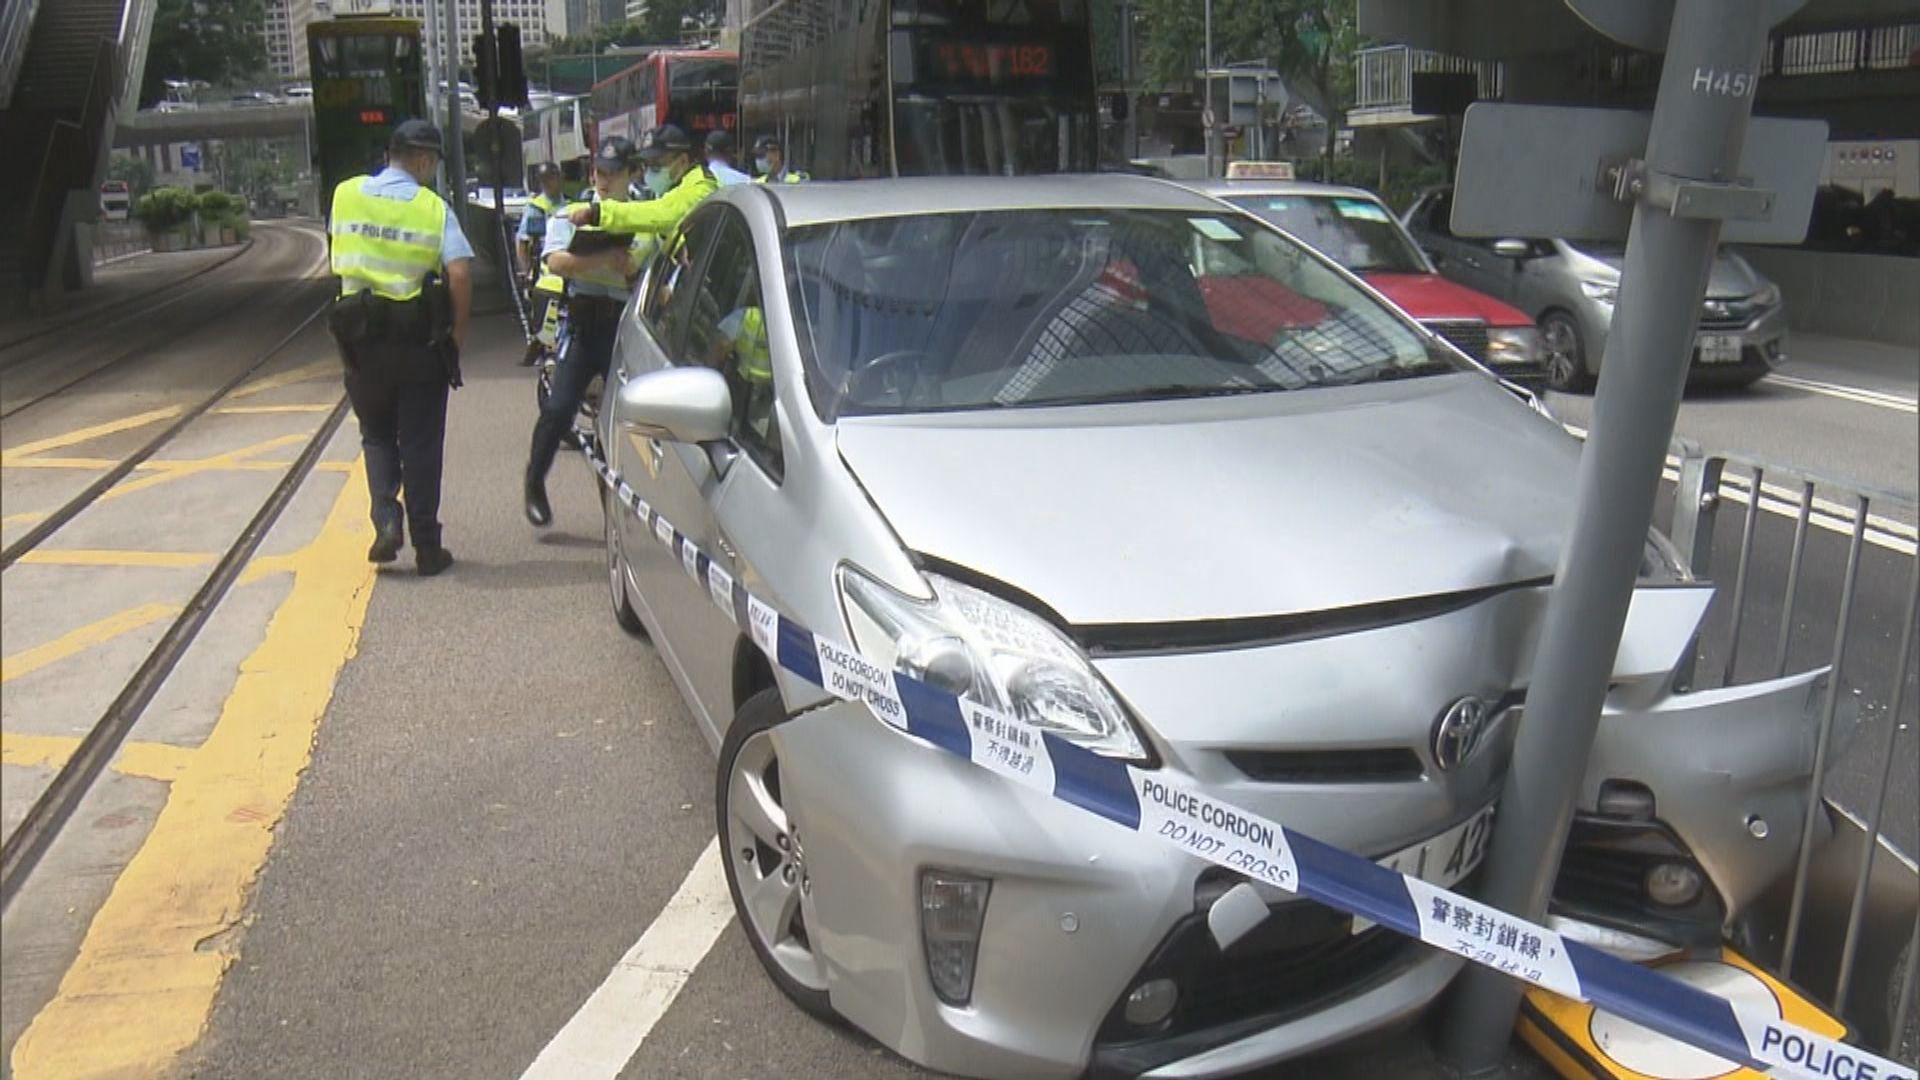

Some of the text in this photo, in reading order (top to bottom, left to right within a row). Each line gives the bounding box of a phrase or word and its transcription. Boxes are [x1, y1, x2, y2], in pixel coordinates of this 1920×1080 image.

[362, 224, 398, 240] POLICE
[820, 642, 849, 669] POLICE
[832, 671, 900, 717] DO NOT CROSS
[1143, 778, 1199, 818] POLICE
[1160, 820, 1291, 884] DO NOT CROSS
[1762, 1025, 1878, 1080] POLICE
